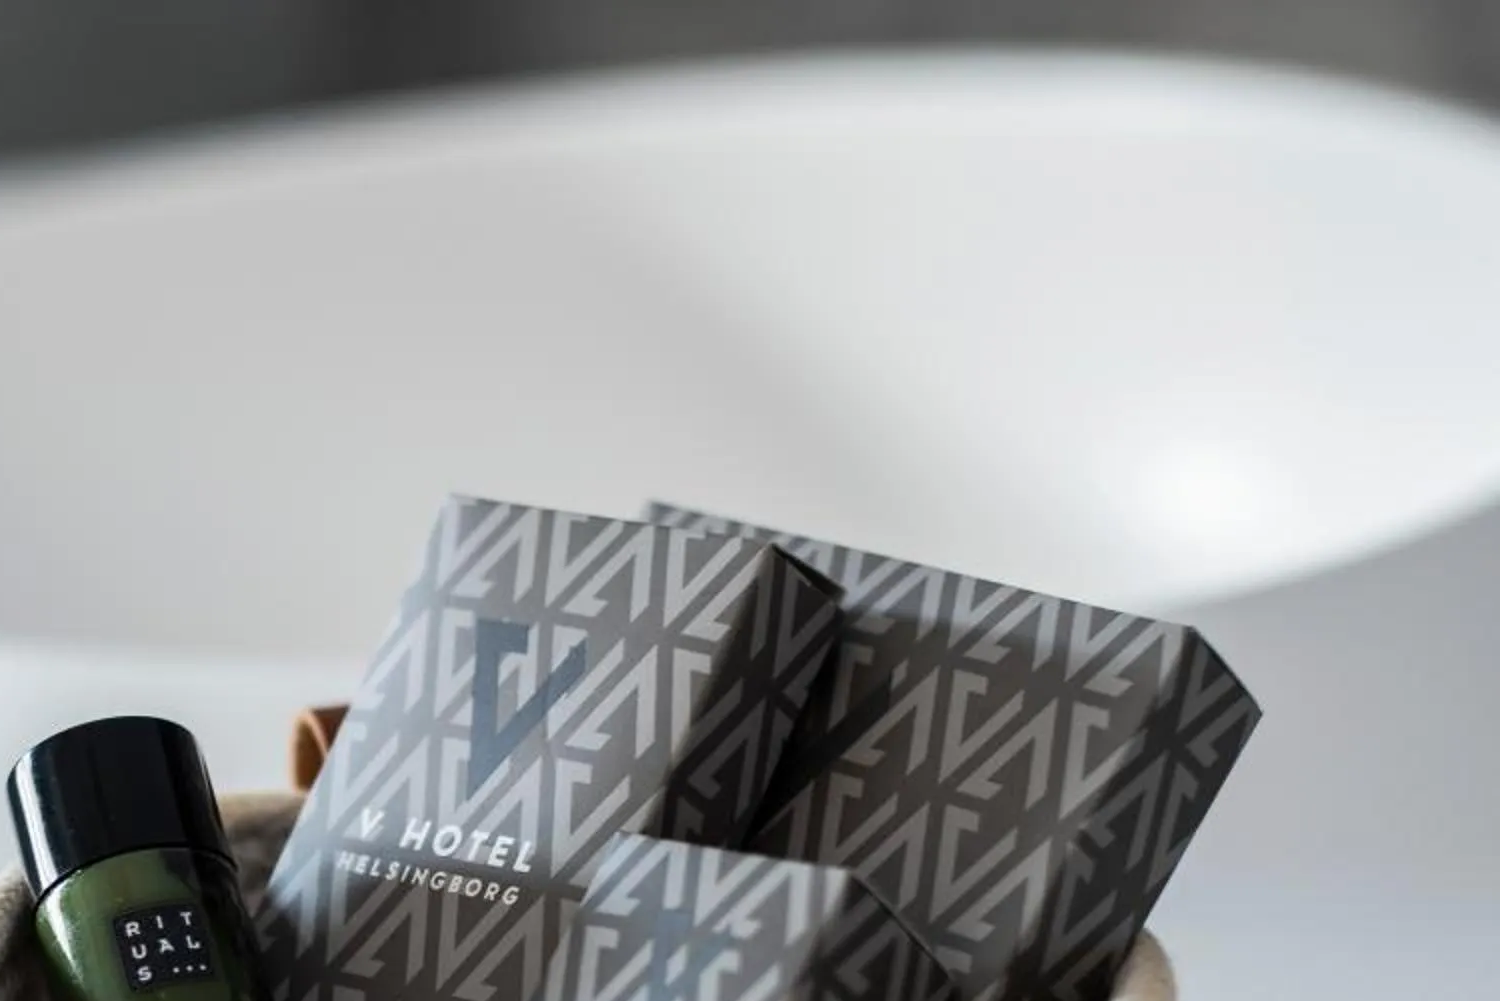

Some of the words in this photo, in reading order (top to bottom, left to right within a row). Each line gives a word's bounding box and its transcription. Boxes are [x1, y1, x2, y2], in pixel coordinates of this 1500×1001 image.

[360, 806, 385, 841] V
[398, 817, 535, 873] HOTEL
[336, 850, 522, 905] HELSINGBORG
